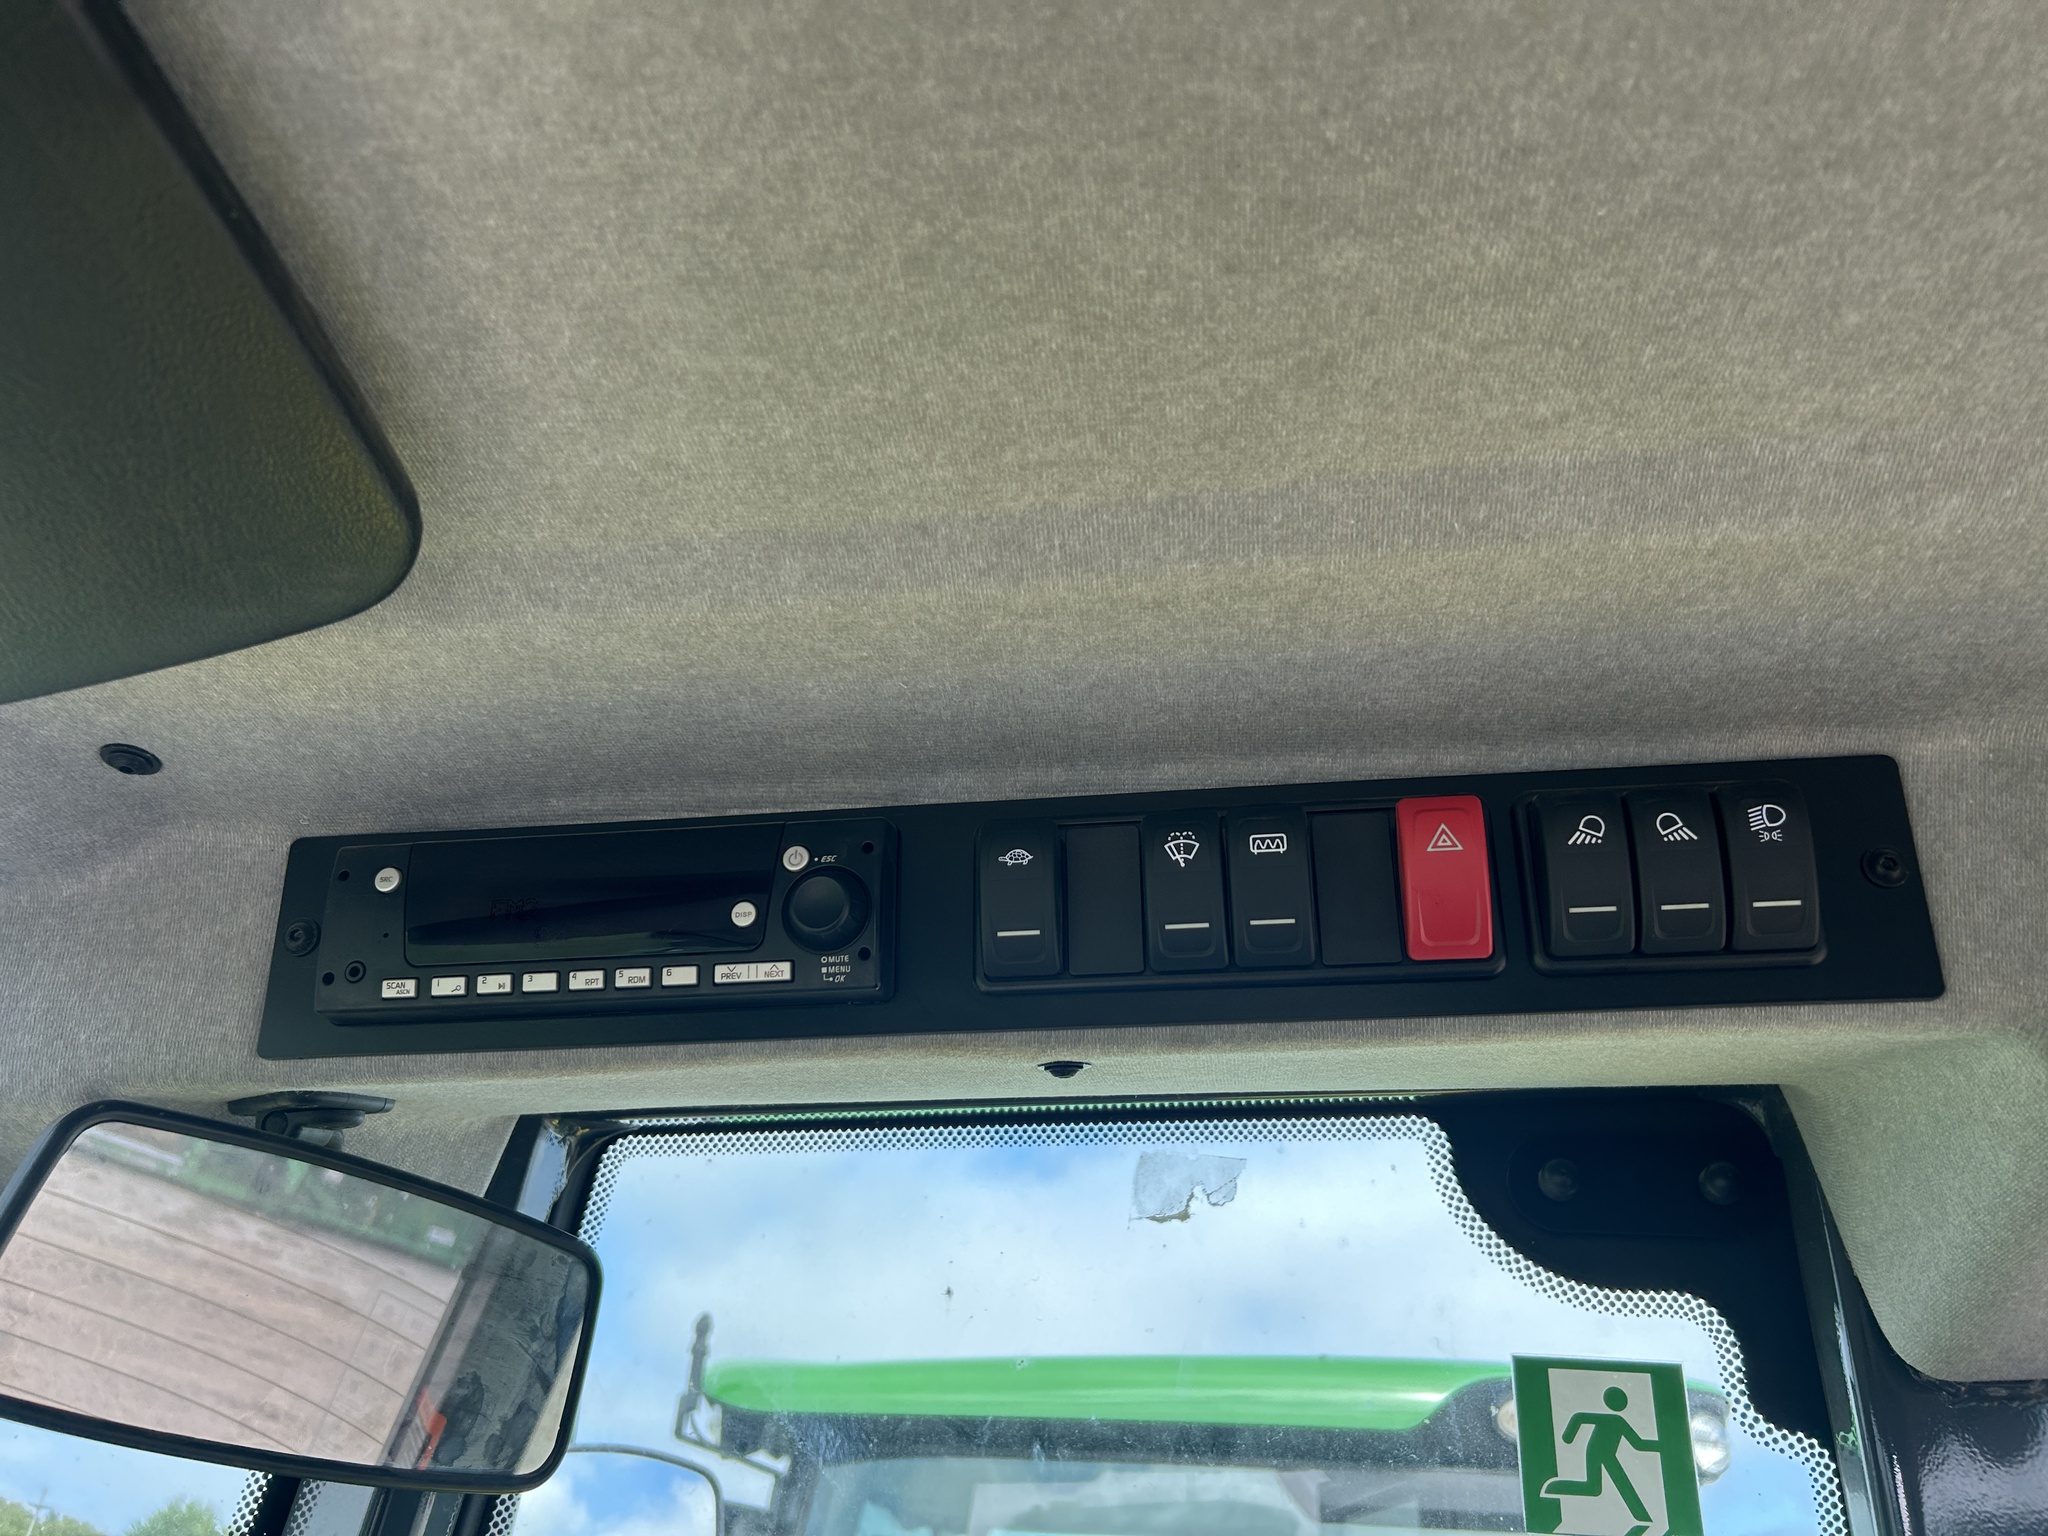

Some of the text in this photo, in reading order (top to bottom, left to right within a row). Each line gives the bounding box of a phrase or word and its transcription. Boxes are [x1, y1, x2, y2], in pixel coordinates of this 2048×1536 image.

[821, 855, 837, 863] ESC
[828, 955, 850, 963] MUTE
[666, 968, 672, 976] 6
[828, 965, 851, 973] MENU
[619, 970, 624, 978] 5
[721, 971, 742, 980] PREV
[764, 969, 785, 978] NEXT
[482, 977, 488, 985] 2
[585, 978, 600, 986] RPT
[628, 975, 646, 984] RDM
[834, 974, 846, 983] OK
[387, 981, 406, 989] SCAN
